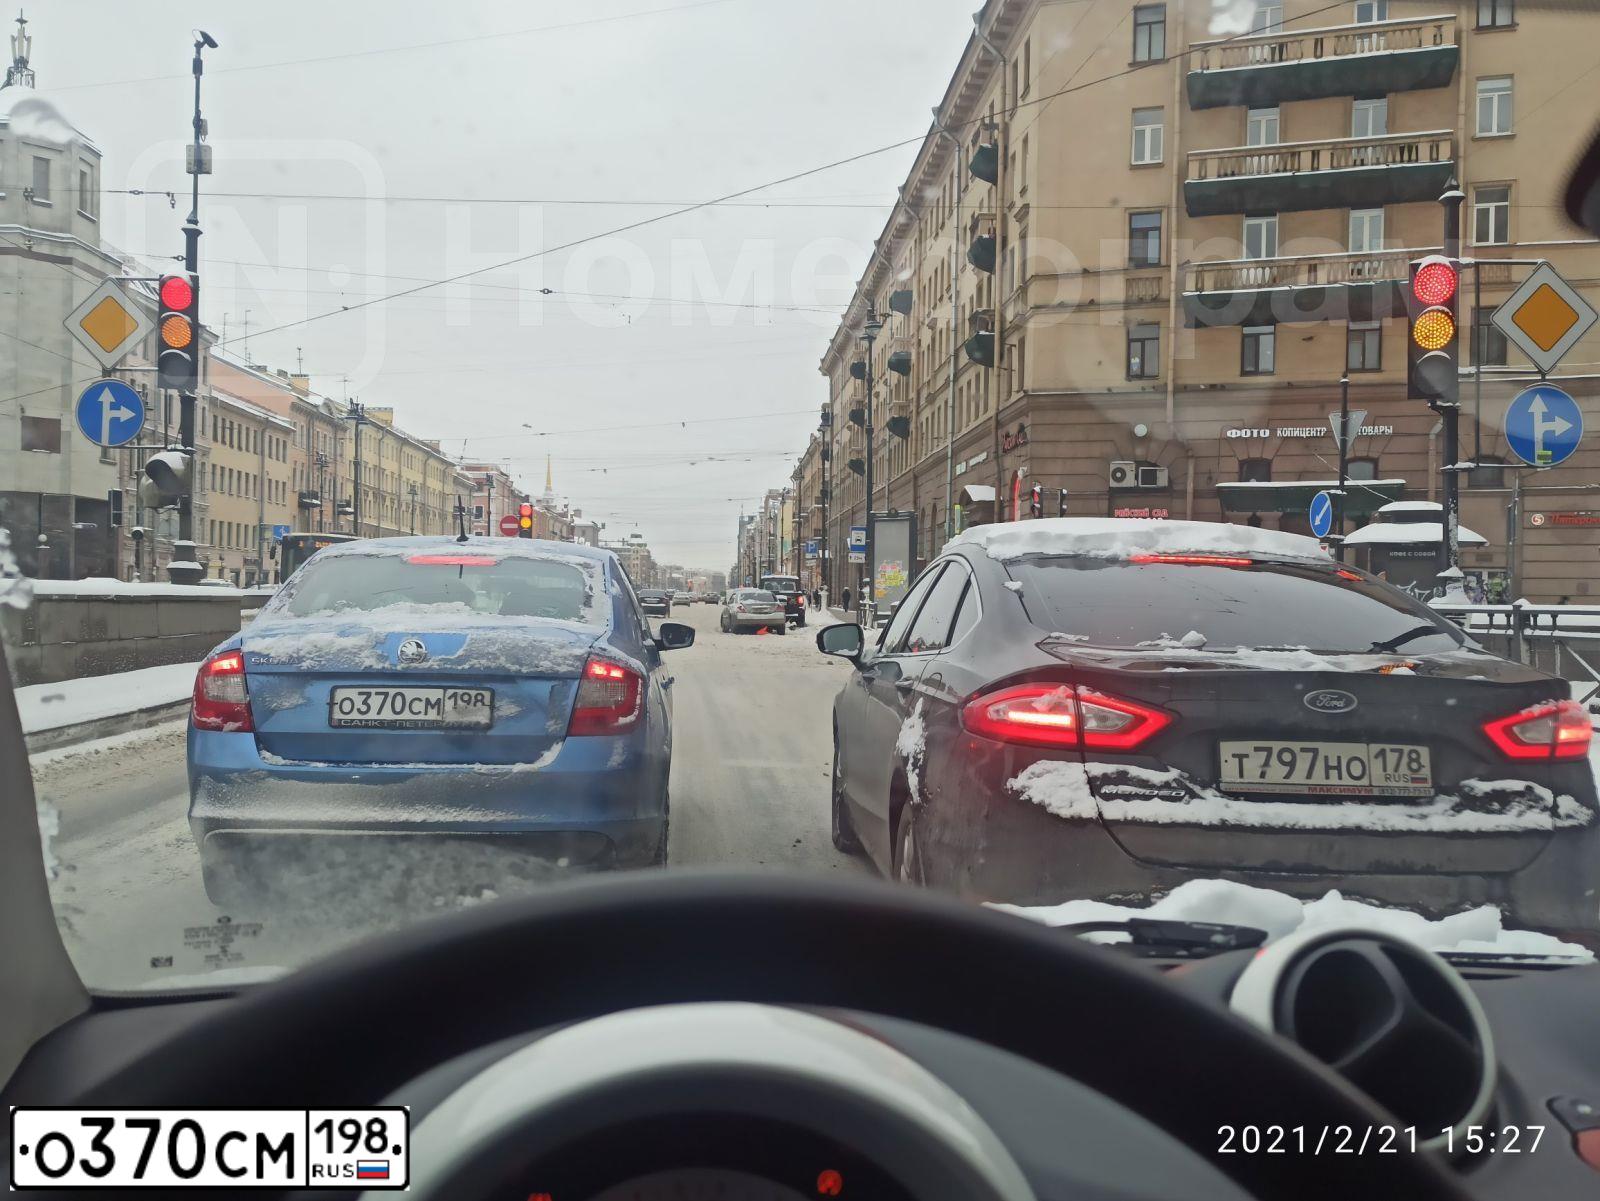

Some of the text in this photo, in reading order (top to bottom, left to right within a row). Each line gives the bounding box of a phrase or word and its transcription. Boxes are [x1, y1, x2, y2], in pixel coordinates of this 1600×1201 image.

[1226, 428, 1270, 438] ФОТО
[1277, 427, 1327, 437] КОПИЦЕНТР
[1316, 693, 1346, 708] Ford
[1374, 747, 1424, 773] 178
[1384, 773, 1409, 783] RUS
[1307, 786, 1374, 795] МАКСИМУМ
